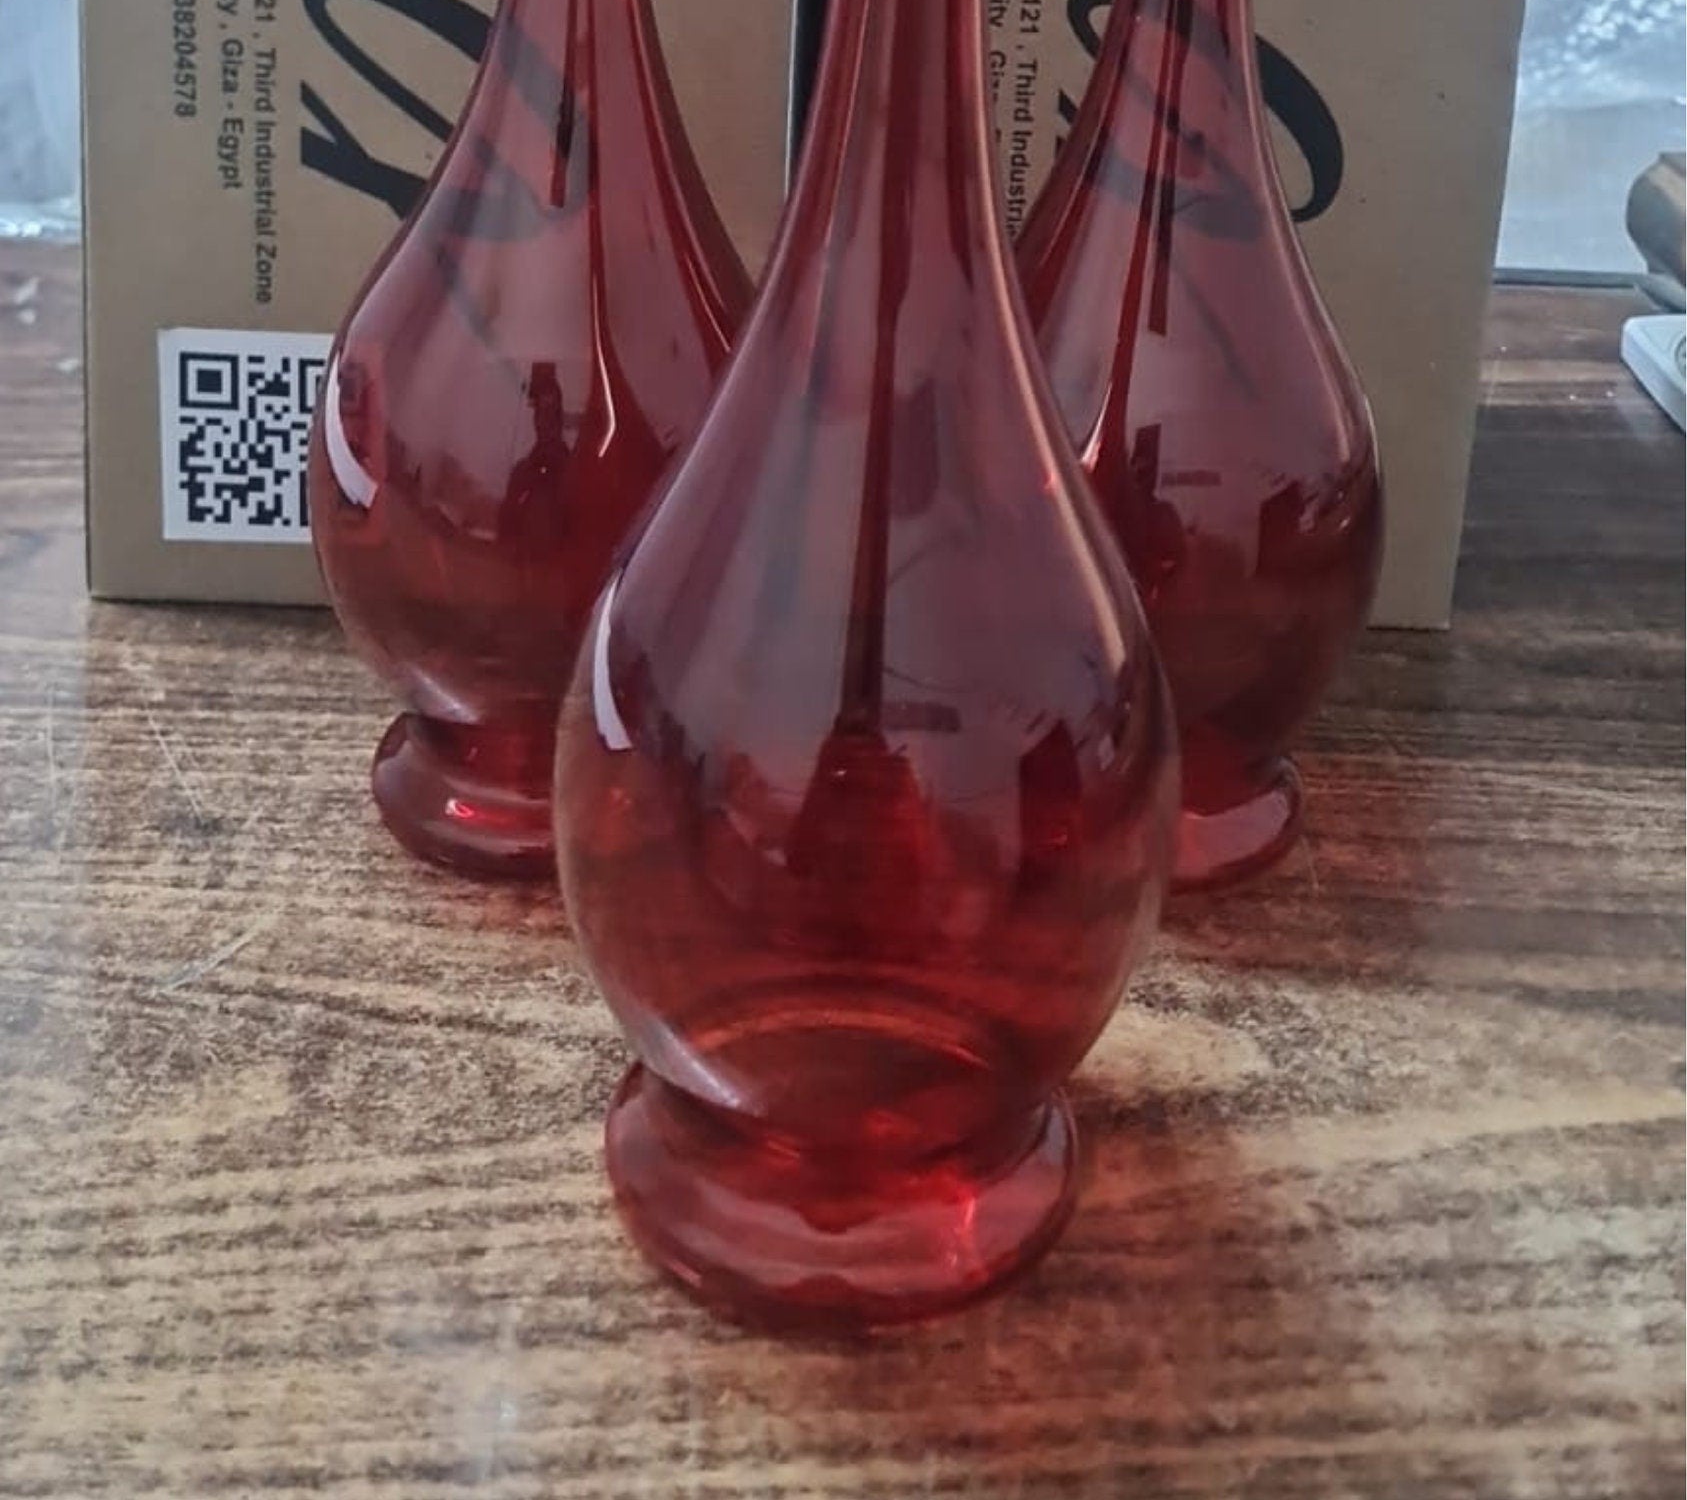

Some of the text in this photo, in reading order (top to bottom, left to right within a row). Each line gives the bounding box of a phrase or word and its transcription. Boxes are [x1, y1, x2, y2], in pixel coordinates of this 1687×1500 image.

[221, 38, 244, 93] Giza
[254, 47, 277, 112] Third
[1013, 60, 1038, 123] Third
[218, 117, 244, 190] Egypt
[255, 120, 277, 236] Industrial
[255, 243, 277, 305] Zone
